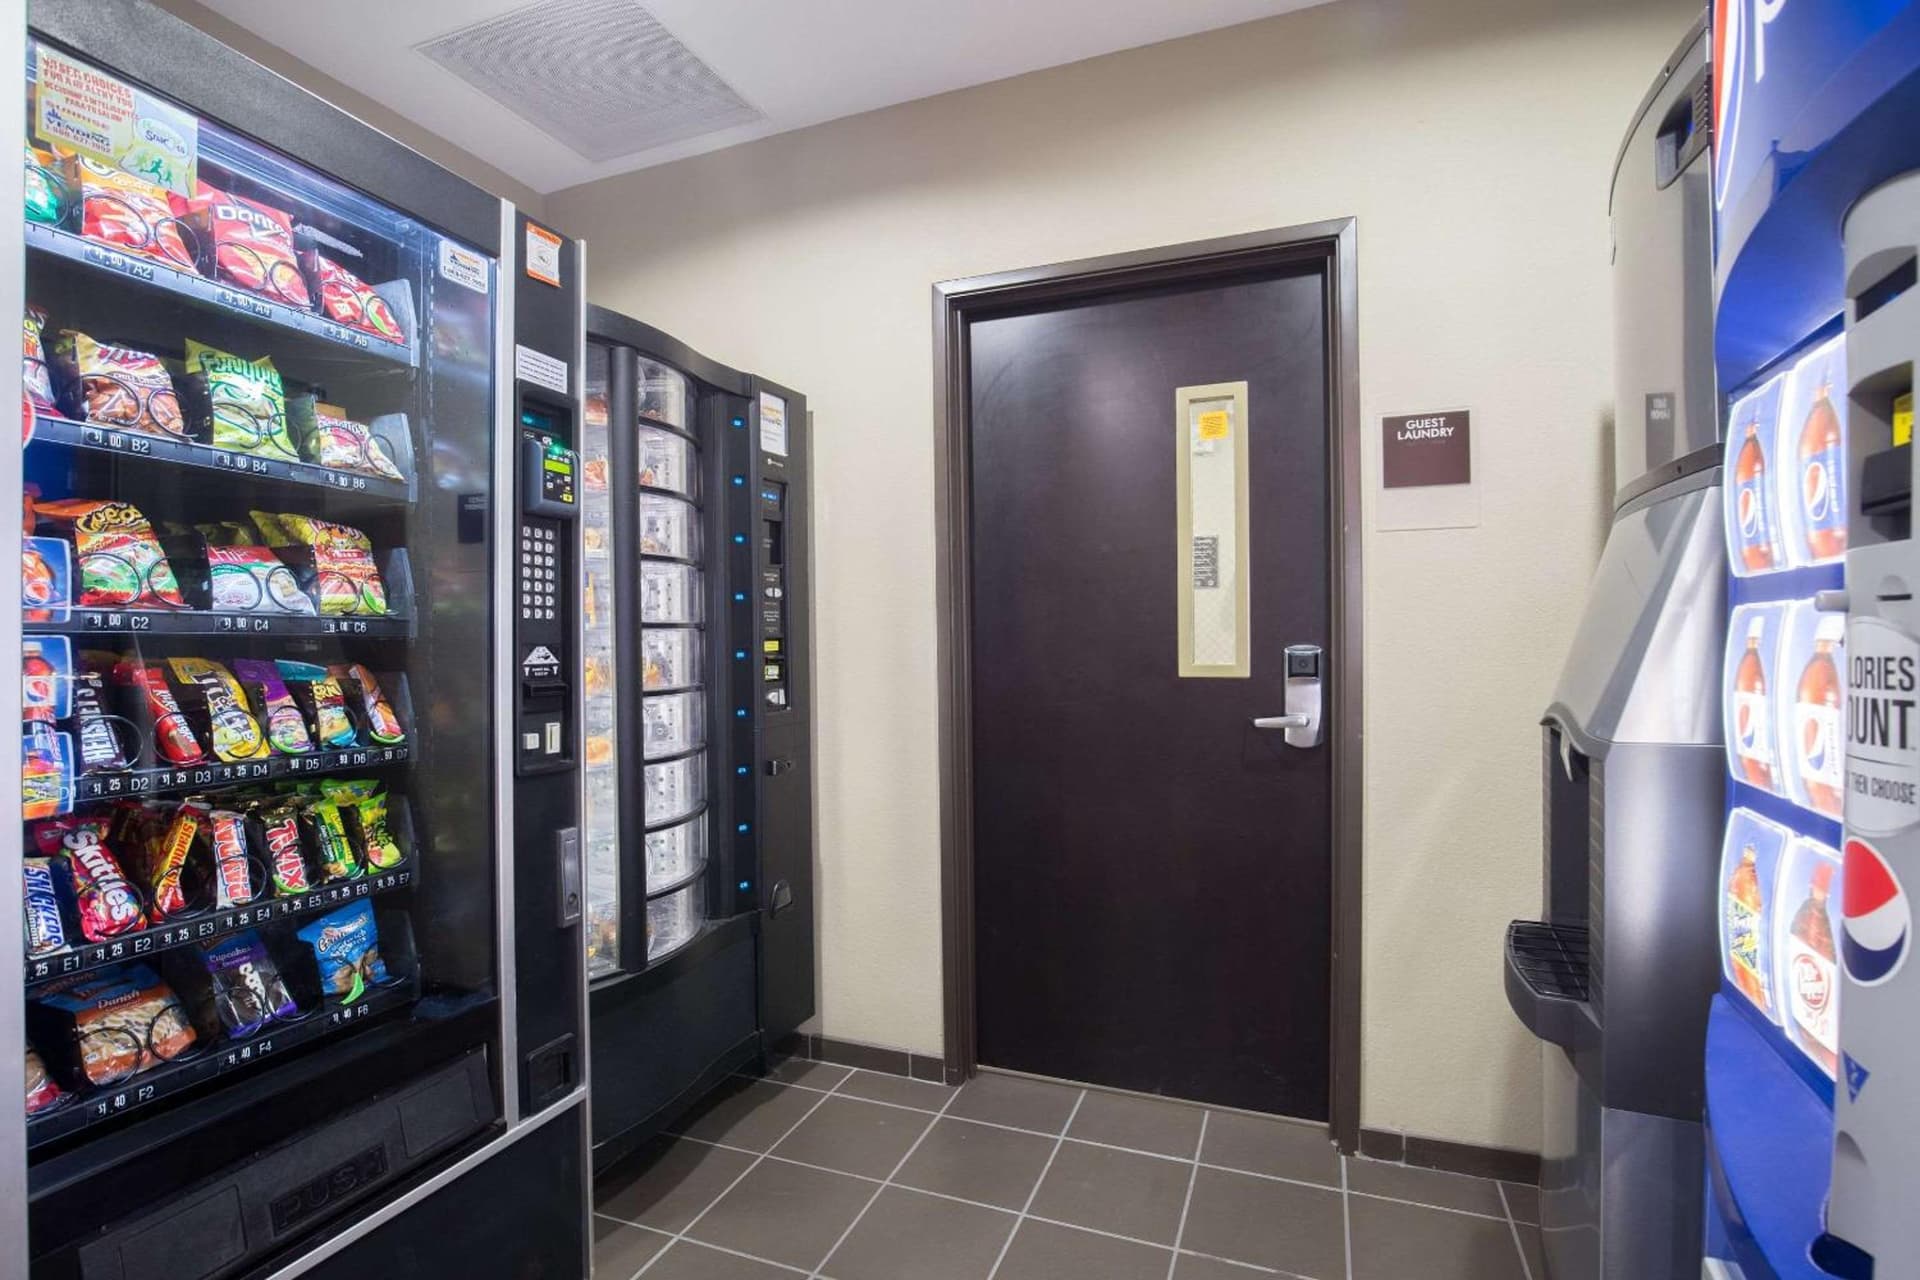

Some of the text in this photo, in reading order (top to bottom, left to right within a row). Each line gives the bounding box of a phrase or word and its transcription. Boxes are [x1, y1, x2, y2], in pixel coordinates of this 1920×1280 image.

[133, 265, 151, 277] A2
[1406, 417, 1447, 430] GUEST
[1397, 427, 1455, 441] LAUNDRY
[131, 438, 149, 453] B2
[252, 460, 268, 473] B4
[131, 616, 149, 630] C2
[254, 619, 269, 632] C4
[354, 621, 367, 633] C6
[306, 758, 320, 770] D5
[354, 753, 366, 765] D6
[253, 764, 268, 777] D4
[195, 771, 212, 784] D3
[131, 778, 149, 791] D2
[1871, 777, 1916, 805] CHOOSE
[64, 831, 135, 921] Skittles
[356, 885, 368, 896] E6
[309, 897, 321, 908] E5
[257, 909, 270, 921] E4
[199, 923, 214, 936] E3
[135, 938, 150, 950] E2
[63, 957, 79, 971] E1
[357, 1005, 369, 1016] F6
[259, 1041, 272, 1054] F4
[139, 1086, 154, 1101] F2
